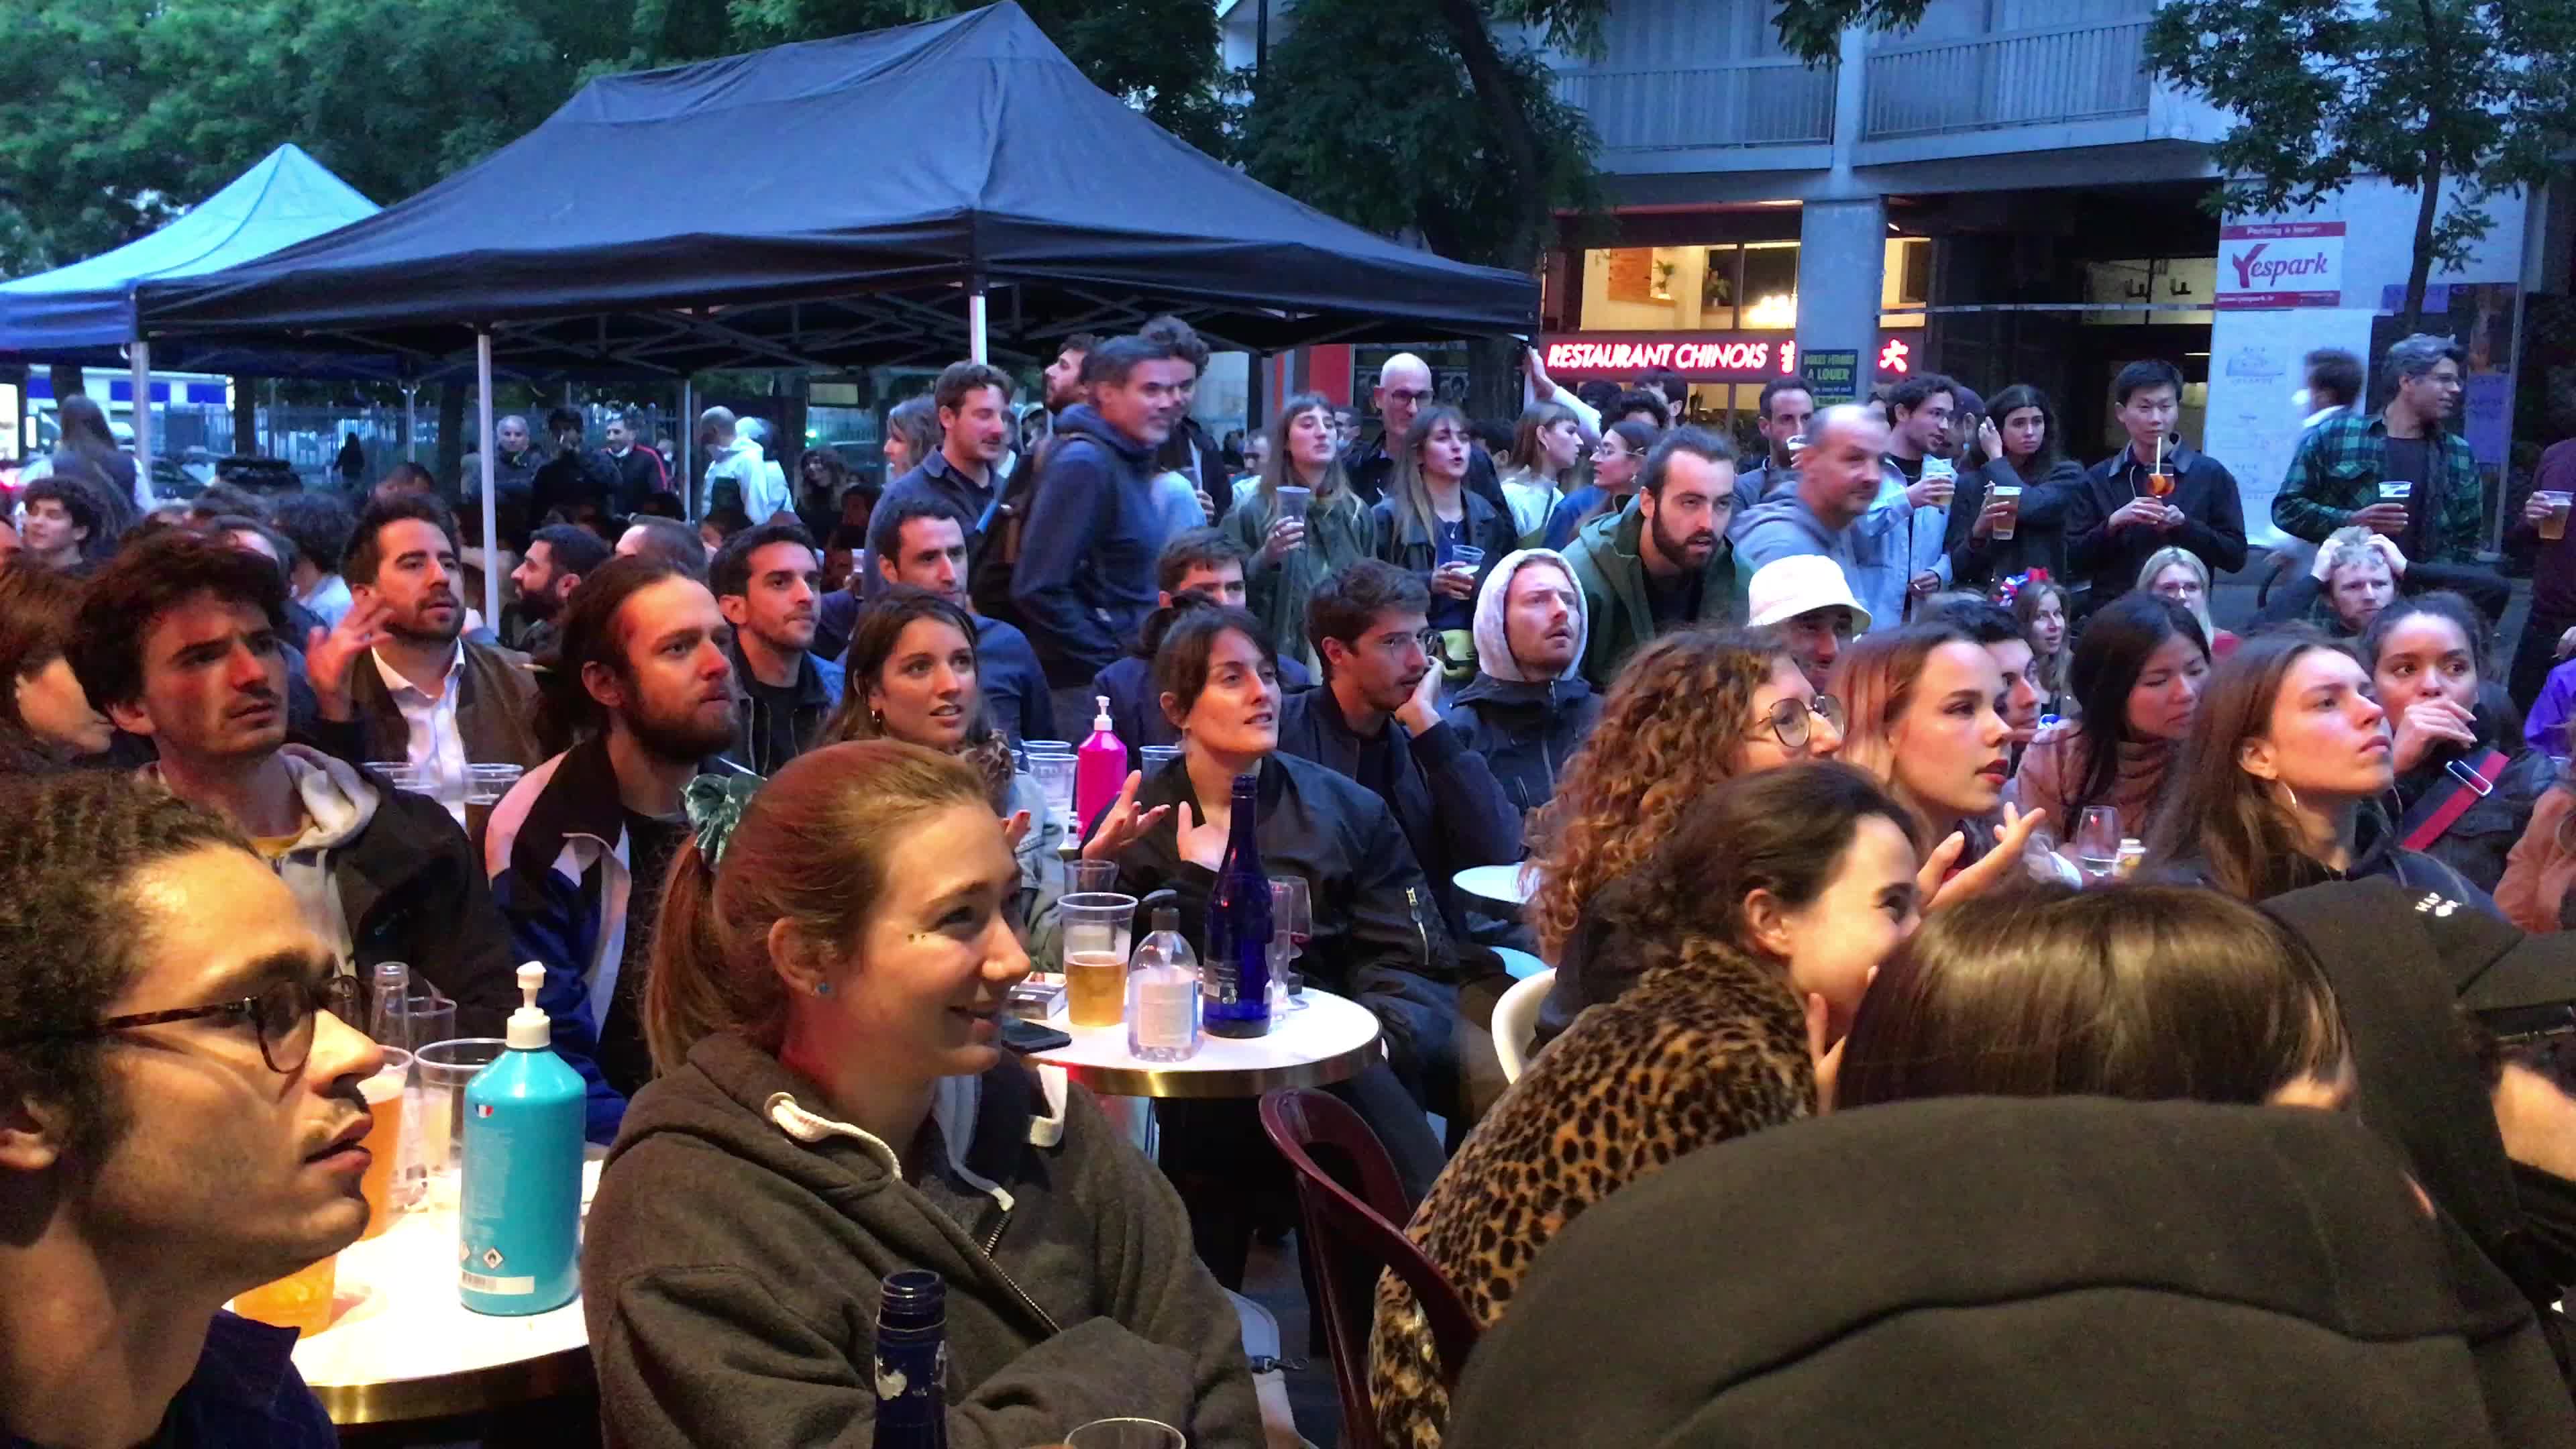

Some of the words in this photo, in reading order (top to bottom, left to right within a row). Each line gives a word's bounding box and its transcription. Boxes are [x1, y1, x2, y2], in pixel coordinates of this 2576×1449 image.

[2232, 243, 2328, 288] Yespark
[1547, 343, 1674, 368] RESTAURANT
[1675, 343, 1769, 368] CHINOIS
[1817, 368, 1851, 381] LOUER
